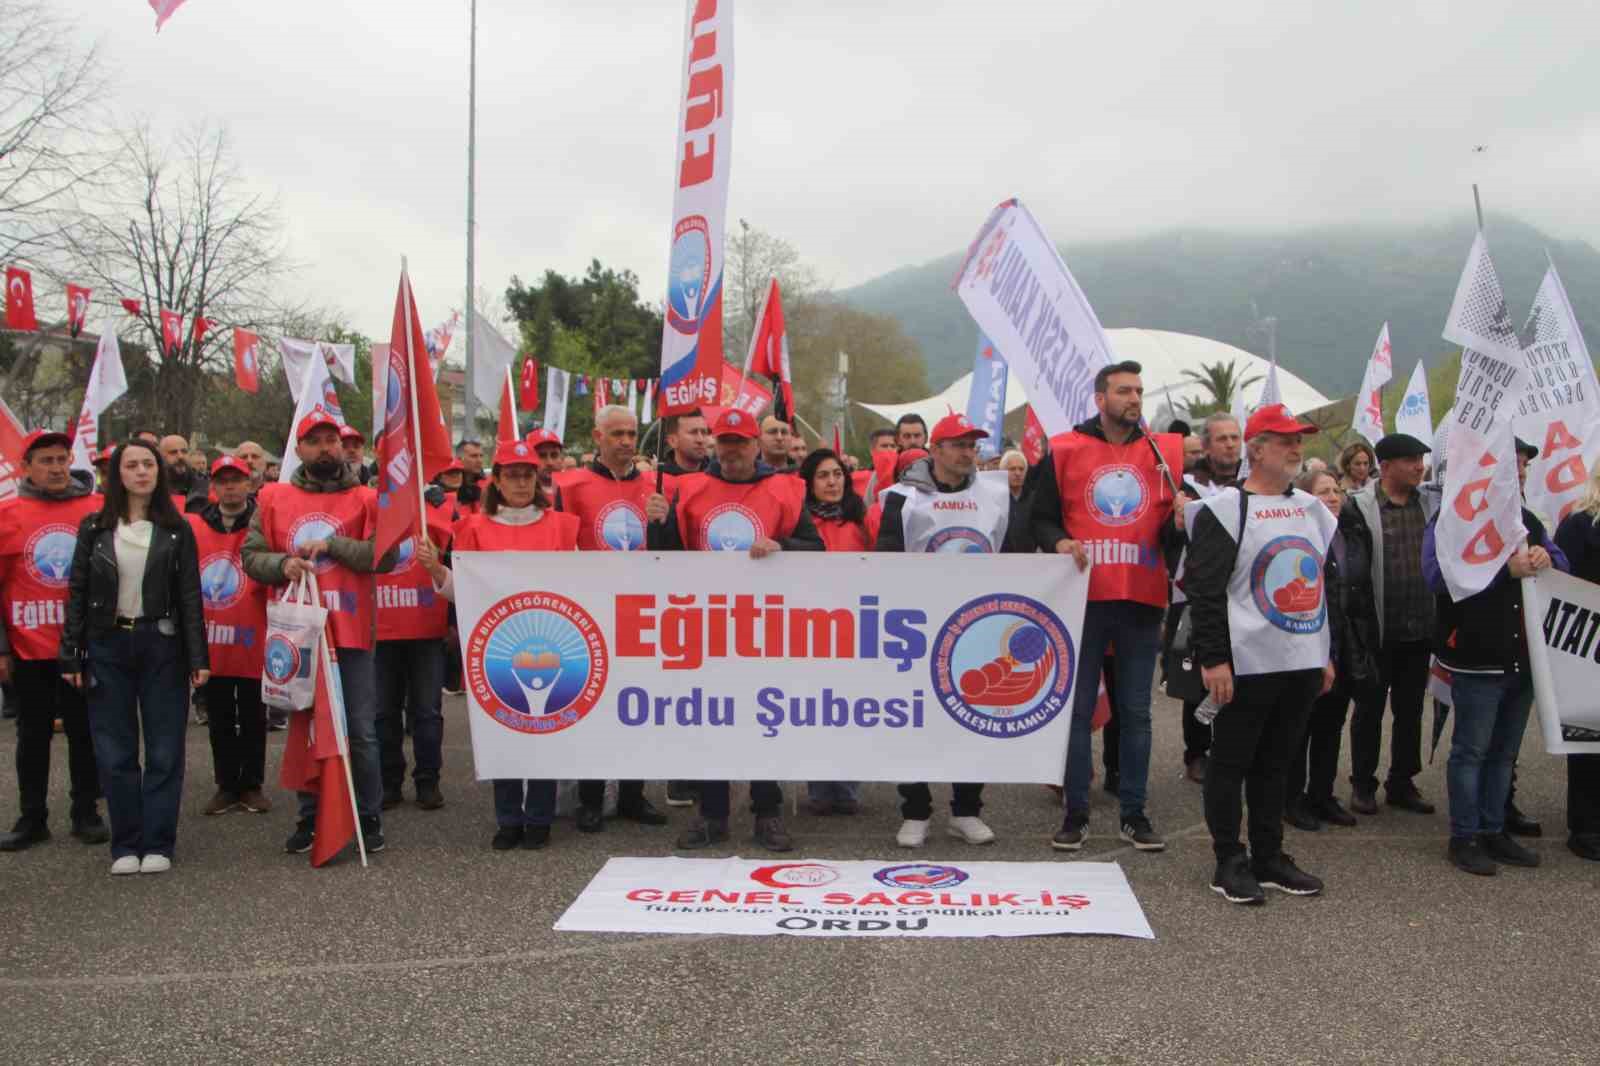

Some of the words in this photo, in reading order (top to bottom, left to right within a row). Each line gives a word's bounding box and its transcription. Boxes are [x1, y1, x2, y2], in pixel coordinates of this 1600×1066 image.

[1543, 597, 1600, 665] ATAT
[617, 686, 735, 727] Ordu
[756, 686, 924, 737] Şubesi
[945, 695, 1003, 734] BİRLEŞİK
[1005, 695, 1061, 733] KAMU-İŞ
[626, 888, 803, 905] GENEL
[776, 916, 928, 932] ORDU
